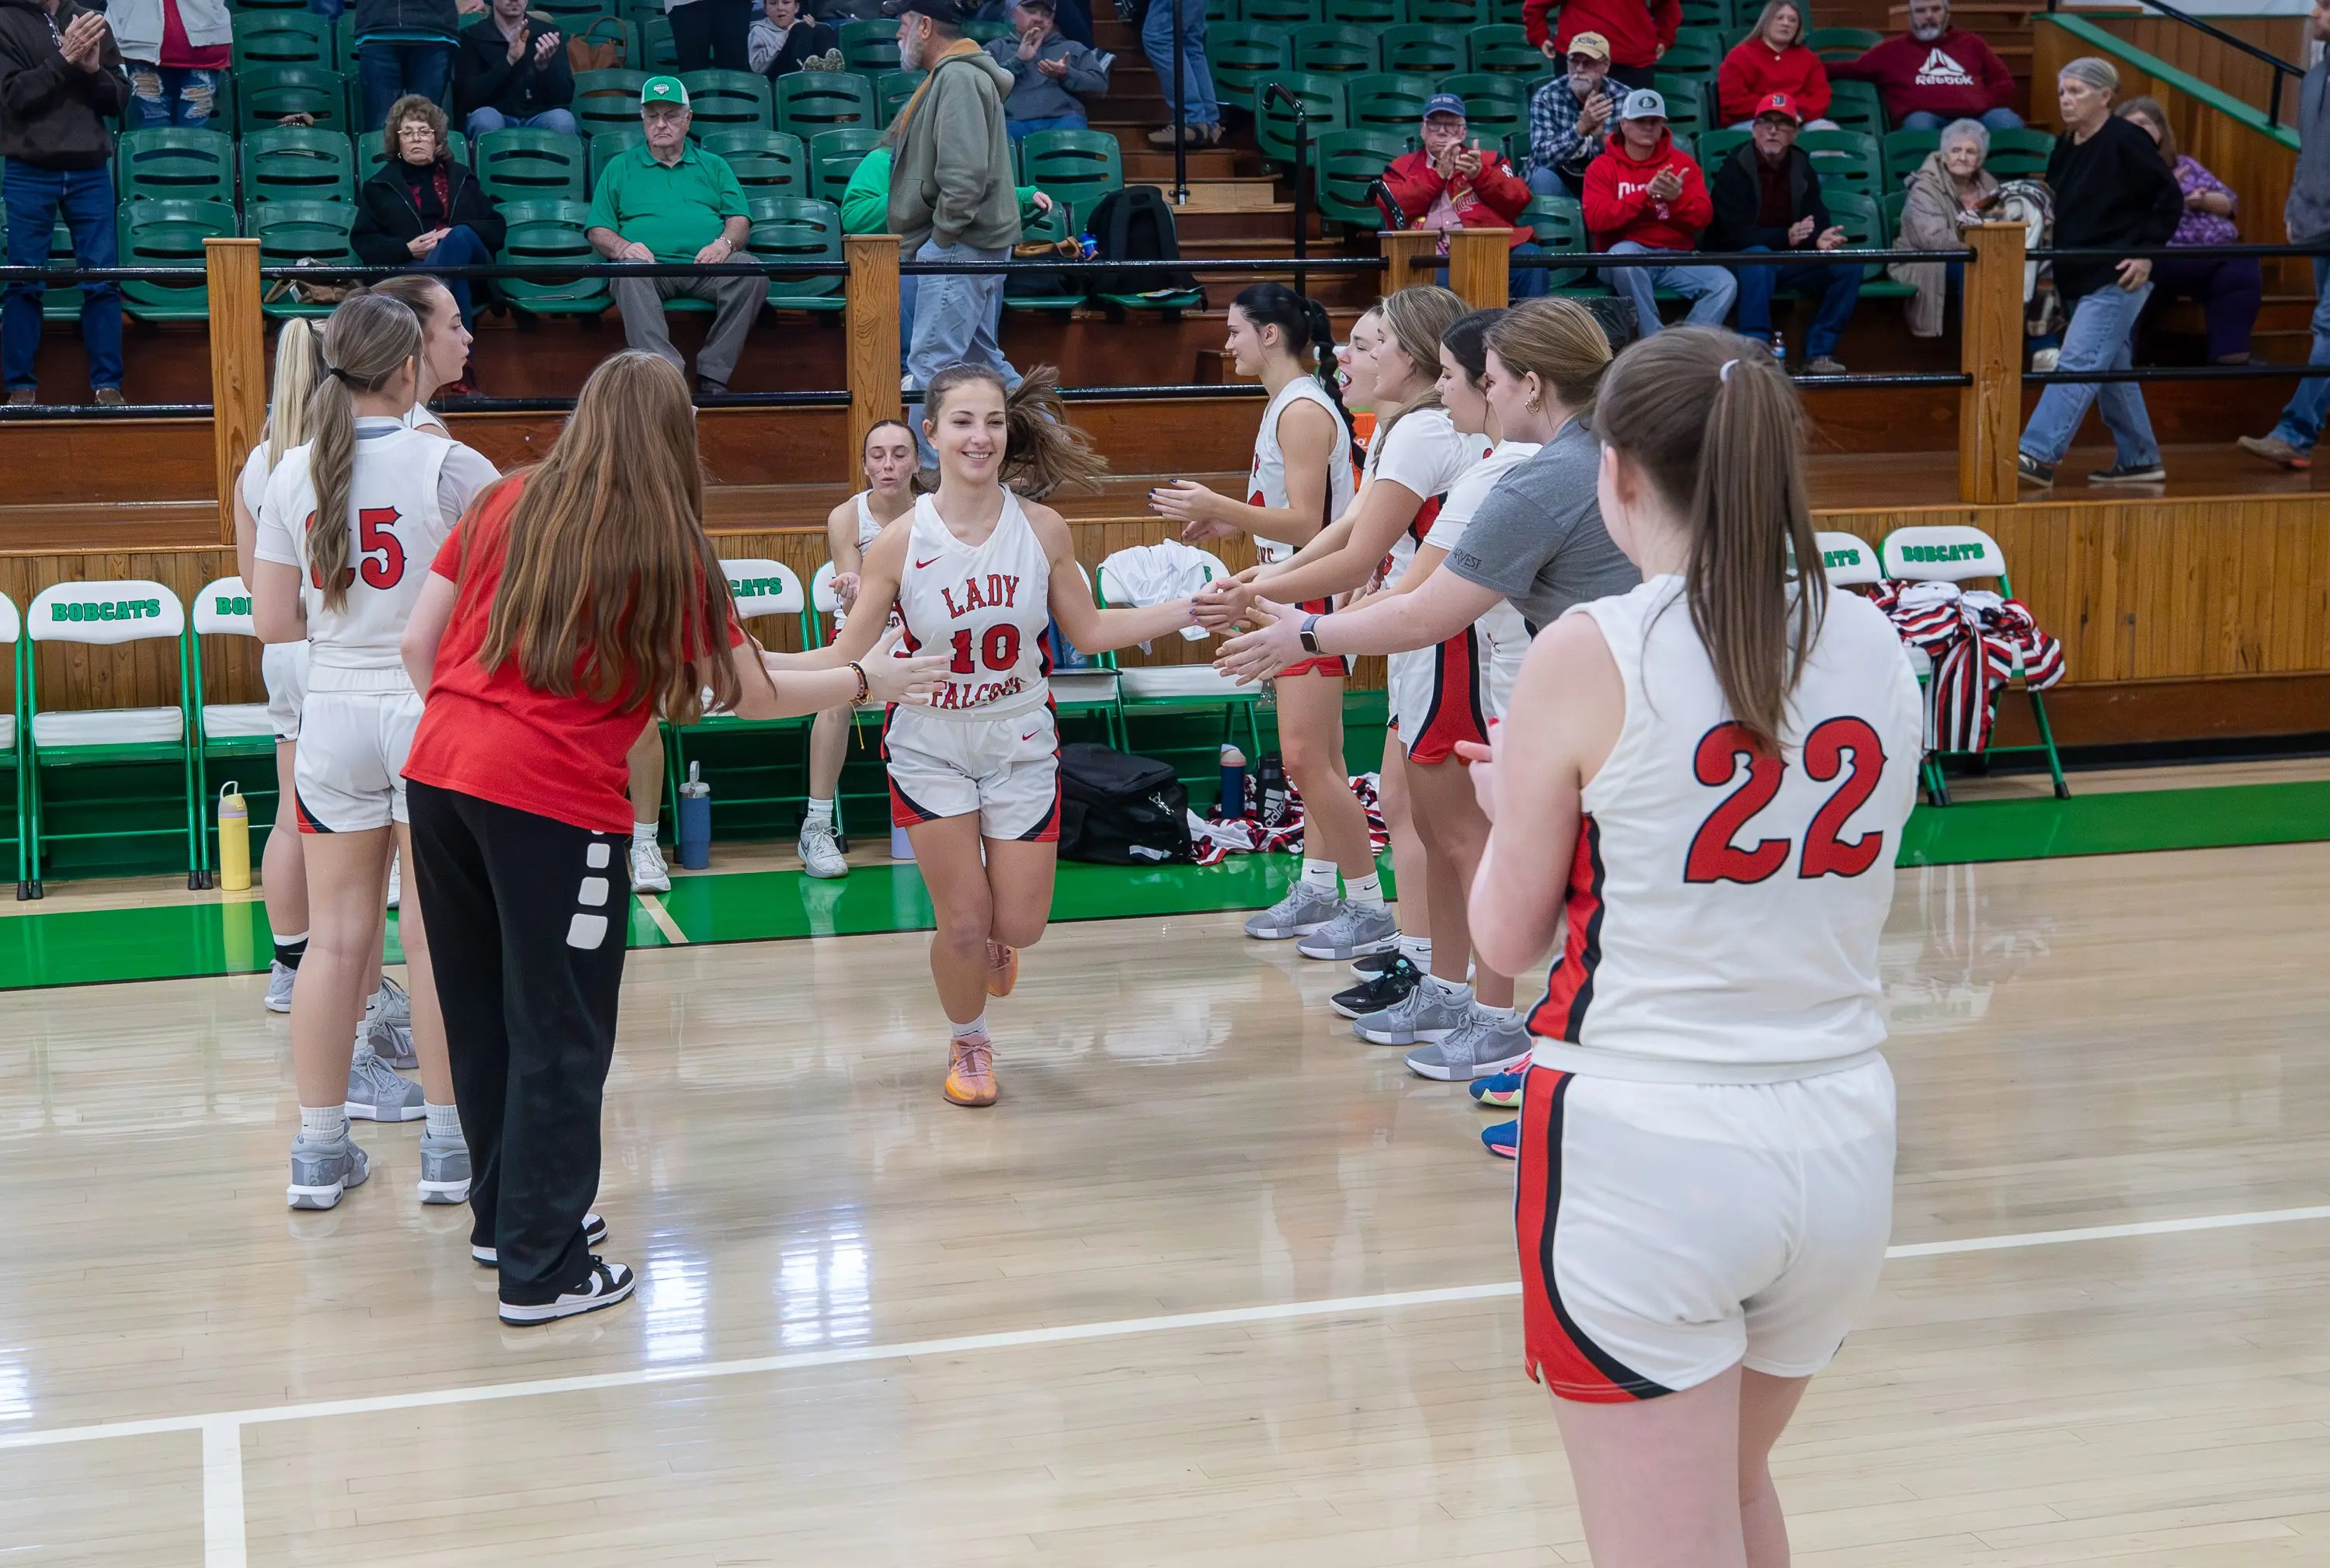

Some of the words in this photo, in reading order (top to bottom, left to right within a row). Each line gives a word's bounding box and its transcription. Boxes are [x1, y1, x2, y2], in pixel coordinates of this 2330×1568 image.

[305, 506, 408, 590] 5
[1901, 543, 1985, 562] BOBCATS
[729, 577, 783, 597] CATS
[941, 574, 1020, 619] LADY
[50, 599, 161, 622] BOBCATS
[949, 623, 1021, 674] 10
[1264, 801, 1285, 828] adid
[1684, 715, 1888, 885] 22
